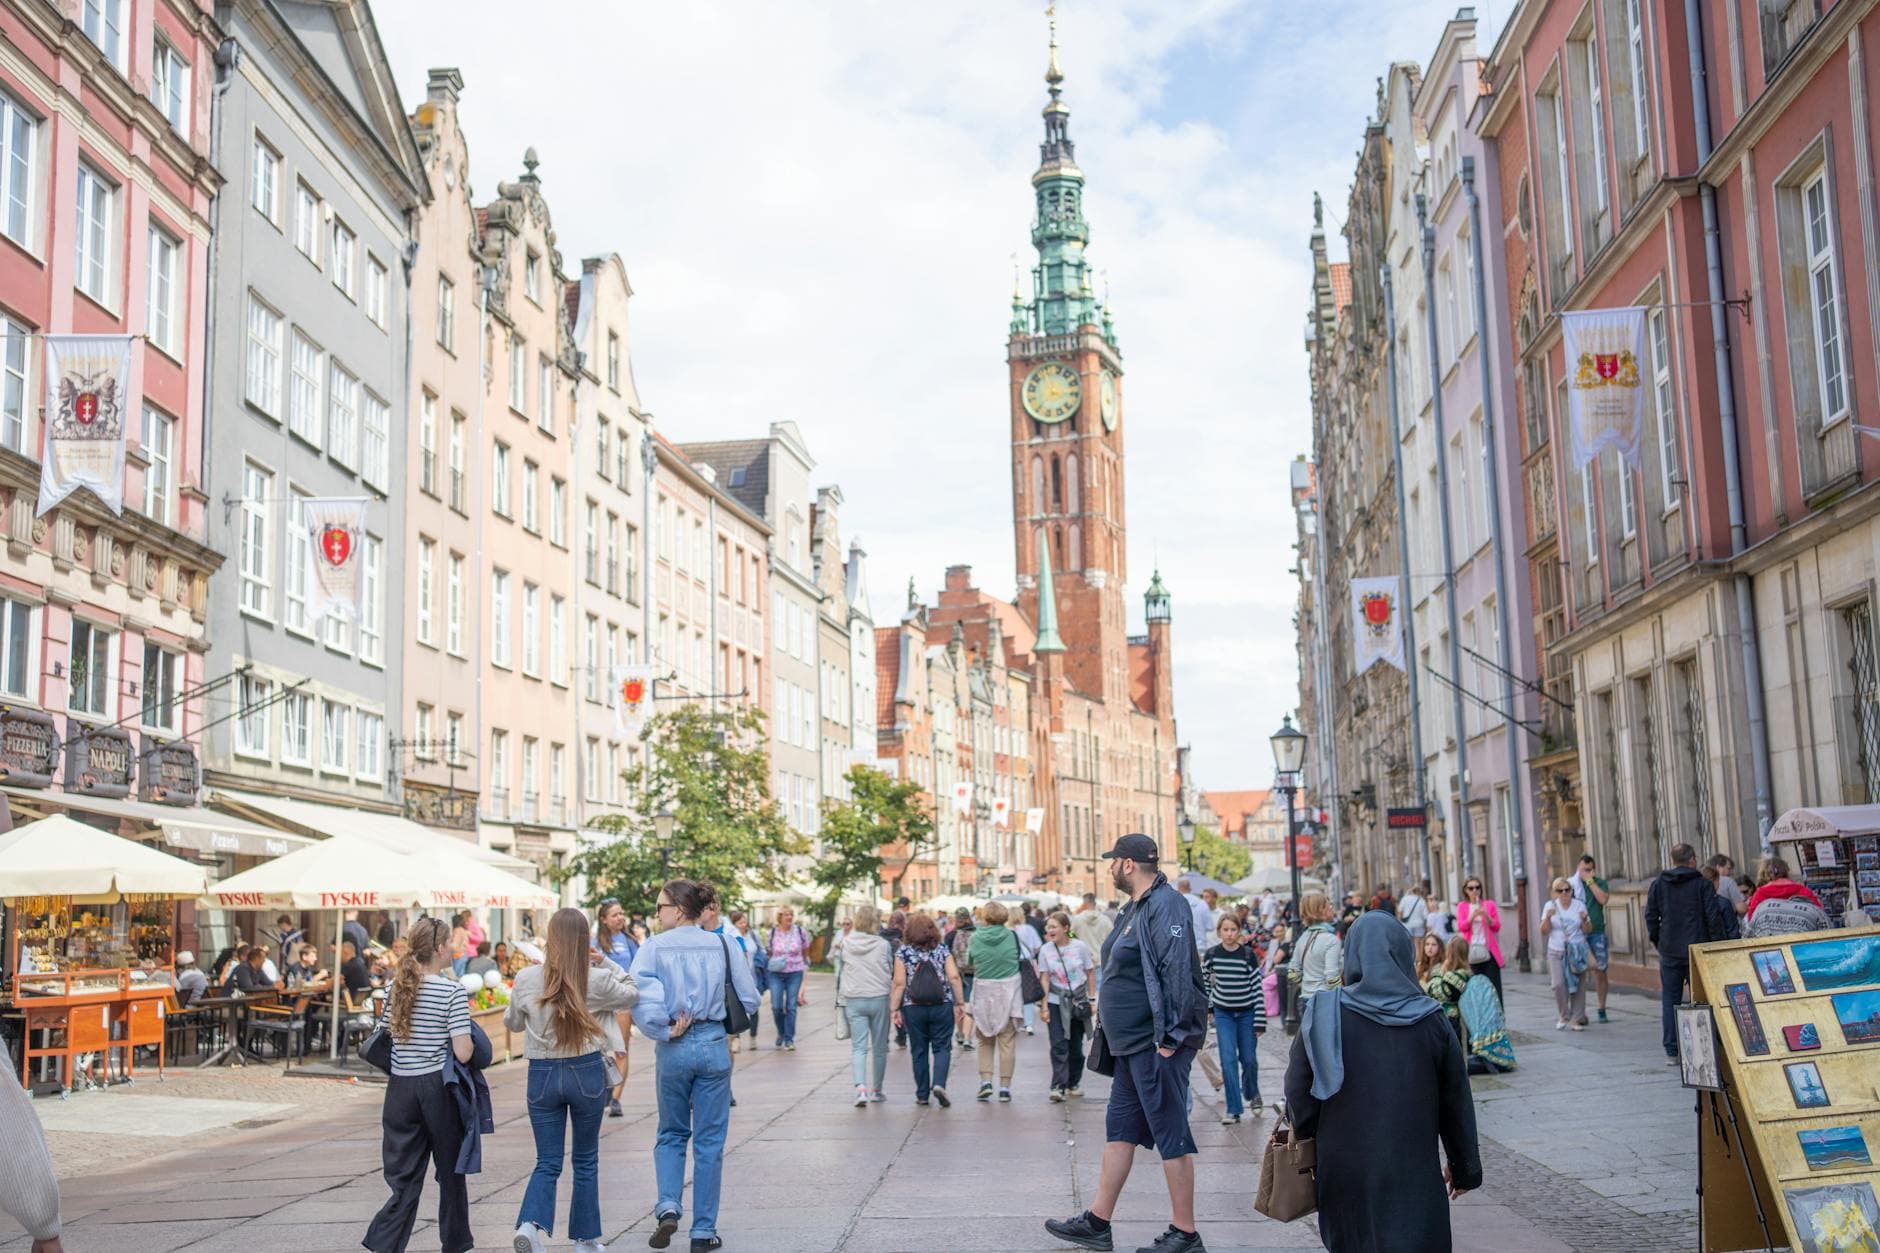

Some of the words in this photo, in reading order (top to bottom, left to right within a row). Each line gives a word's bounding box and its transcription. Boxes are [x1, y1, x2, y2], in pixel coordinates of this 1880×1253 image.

[7, 735, 47, 757] PIZZERIA
[90, 748, 126, 772] NAPOLI
[1389, 815, 1425, 825] WECHSEL
[1805, 822, 1826, 832] Polska
[216, 893, 265, 905] TYSKIE
[319, 892, 379, 906] TYSKIE
[431, 890, 466, 904] TYSKIE
